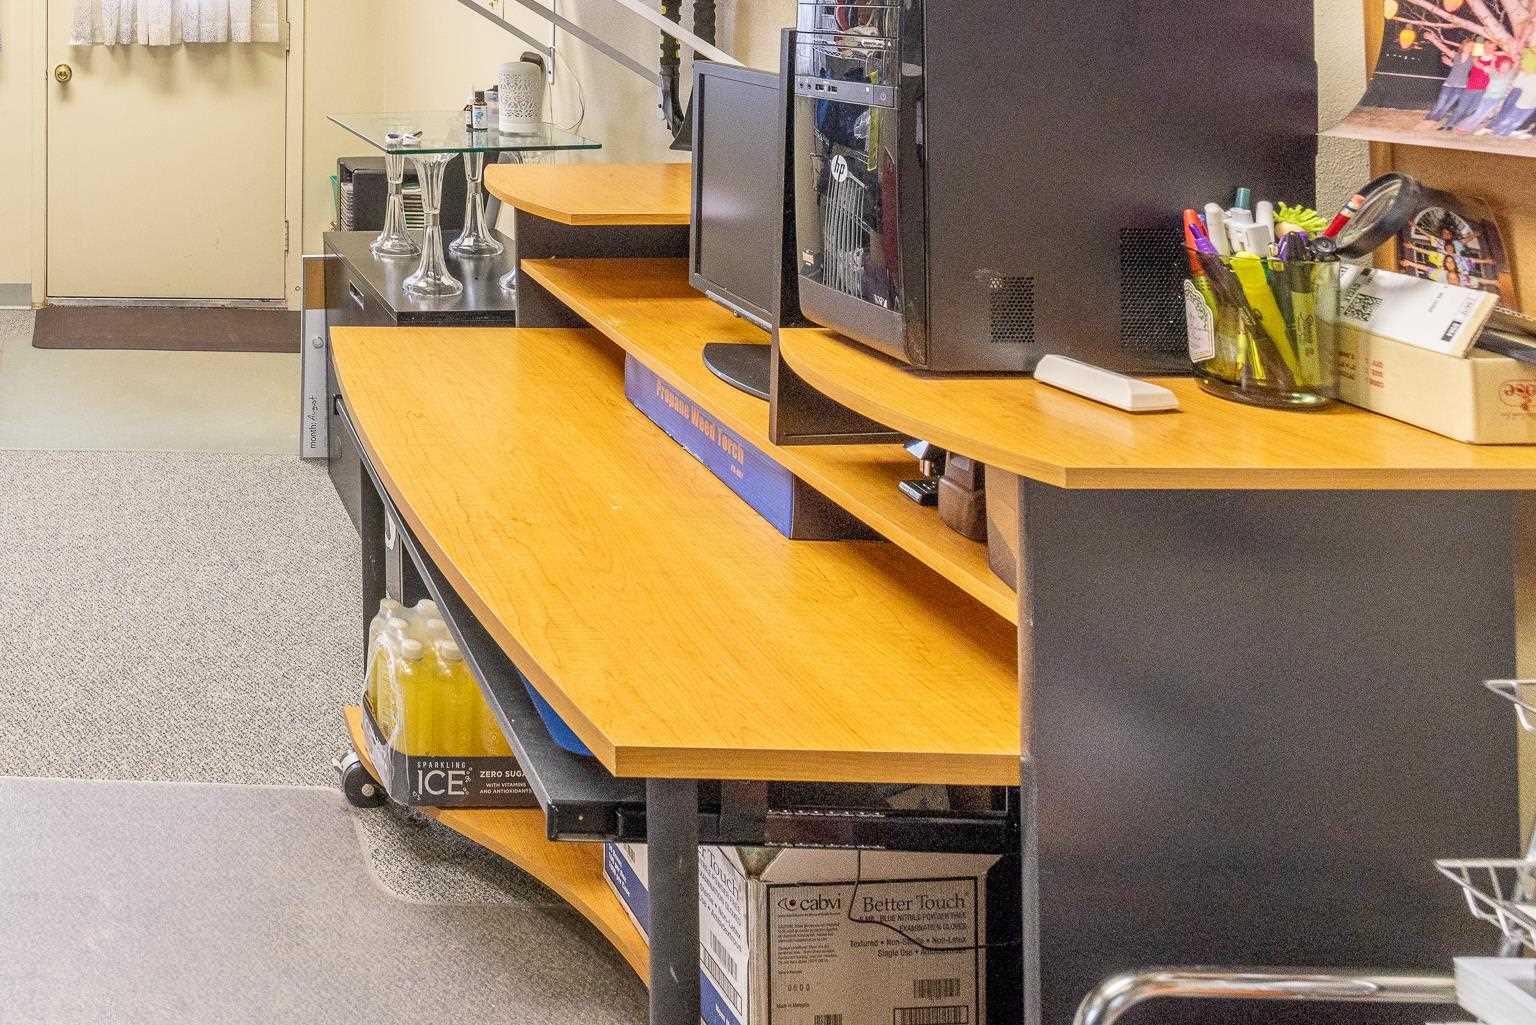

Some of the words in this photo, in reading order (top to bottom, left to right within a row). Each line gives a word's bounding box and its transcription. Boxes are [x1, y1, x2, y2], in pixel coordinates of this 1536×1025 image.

[417, 761, 466, 769] SPARKLING
[479, 770, 502, 778] ZERO
[417, 770, 465, 795] ICE
[800, 893, 842, 911] cabvi
[863, 896, 913, 912] Better
[916, 893, 965, 910] Touch
